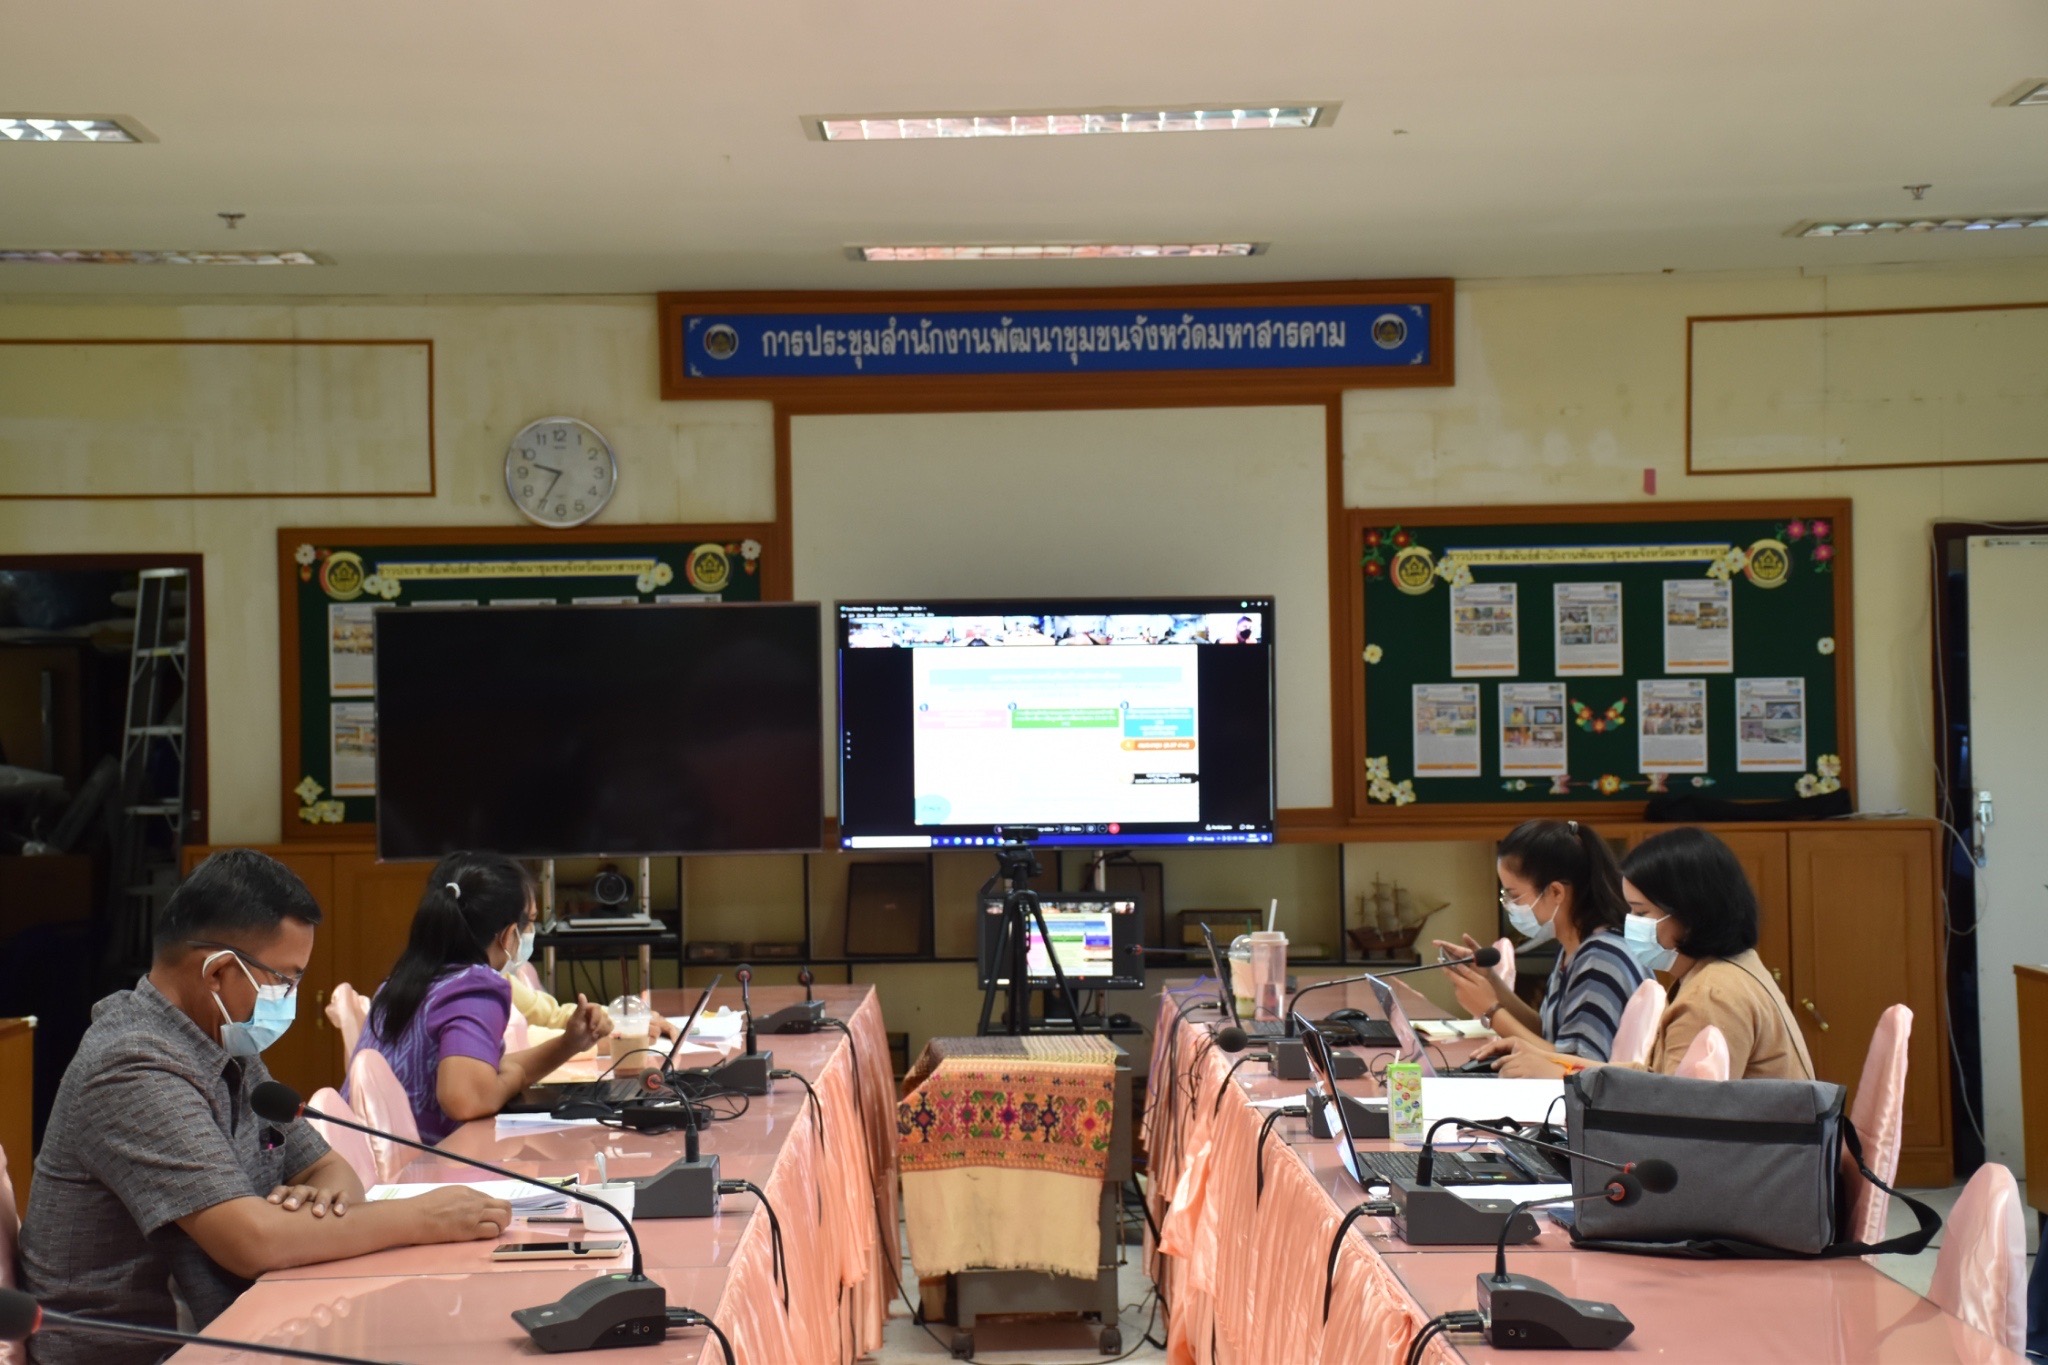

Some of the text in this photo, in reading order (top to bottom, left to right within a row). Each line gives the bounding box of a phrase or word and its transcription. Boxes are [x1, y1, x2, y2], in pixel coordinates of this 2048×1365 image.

[536, 433, 547, 446] 11
[552, 428, 567, 442] 12
[577, 433, 583, 446] 1
[521, 448, 536, 461] 10
[587, 446, 599, 461] 2
[517, 465, 529, 479] 9
[593, 466, 604, 480] 3
[522, 485, 534, 498] 8
[587, 485, 598, 497] 4
[555, 503, 567, 517] 6
